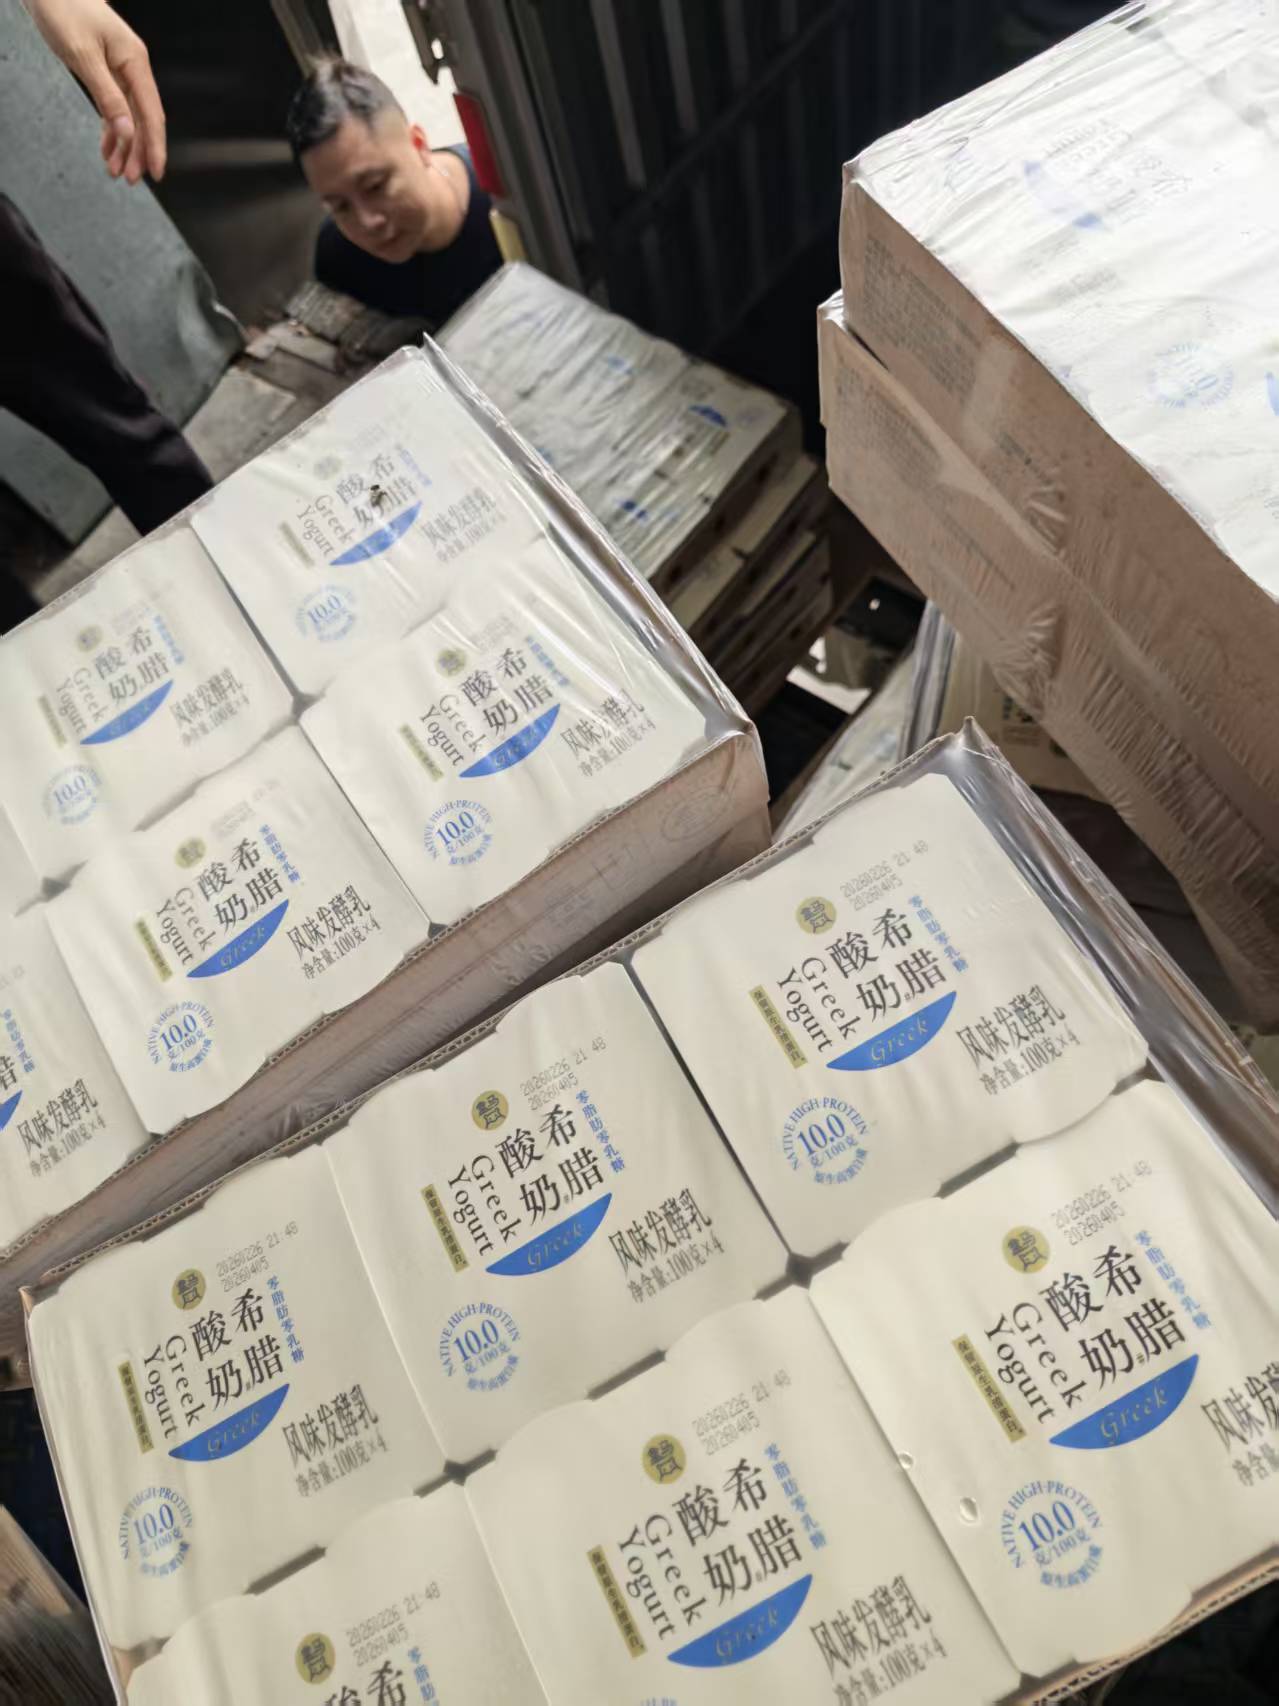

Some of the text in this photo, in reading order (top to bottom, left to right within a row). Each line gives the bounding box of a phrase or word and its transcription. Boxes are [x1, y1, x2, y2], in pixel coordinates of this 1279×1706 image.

[420, 707, 464, 767] Yogurt
[439, 695, 486, 754] Greek
[436, 810, 474, 848] 10.0
[155, 900, 193, 966] Yogurt
[174, 888, 216, 953] Greek
[285, 884, 372, 961] 风味发酵乳
[159, 1016, 197, 1054] 10.0
[777, 968, 832, 1052] Yogurt
[801, 957, 861, 1040] Greek
[956, 984, 1066, 1069] 风味发酵乳
[870, 1016, 930, 1065] Greek
[17, 1078, 98, 1154] 风味发酵乳
[576, 1090, 626, 1172] 零脂肪零乳糖
[782, 1123, 800, 1171] NATIVE
[797, 1113, 845, 1158] 10.0
[447, 1166, 493, 1256] Yogurt
[471, 1154, 522, 1243] Greek
[608, 1186, 714, 1275] 风味发酵乳
[526, 1218, 584, 1269] Greek
[267, 1275, 305, 1363] 零脂肪零乳糖
[439, 1329, 454, 1378] NATIVE
[453, 1320, 499, 1365] 10.0
[1012, 1302, 1088, 1409] Greek
[142, 1346, 178, 1439] Yogurt
[165, 1335, 206, 1428] Greek
[983, 1315, 1056, 1423] Yogurt
[283, 1383, 382, 1468] 风味发酵乳
[1100, 1385, 1169, 1443] Greek
[1200, 1362, 1279, 1454] 风味发
[134, 1506, 174, 1543] 10.0
[1000, 1512, 1023, 1571] NATIVE
[1018, 1503, 1076, 1557] 10.0
[618, 1526, 675, 1639] Yogurt
[645, 1513, 707, 1625] Greek
[809, 1573, 934, 1681] 风味发酵乳
